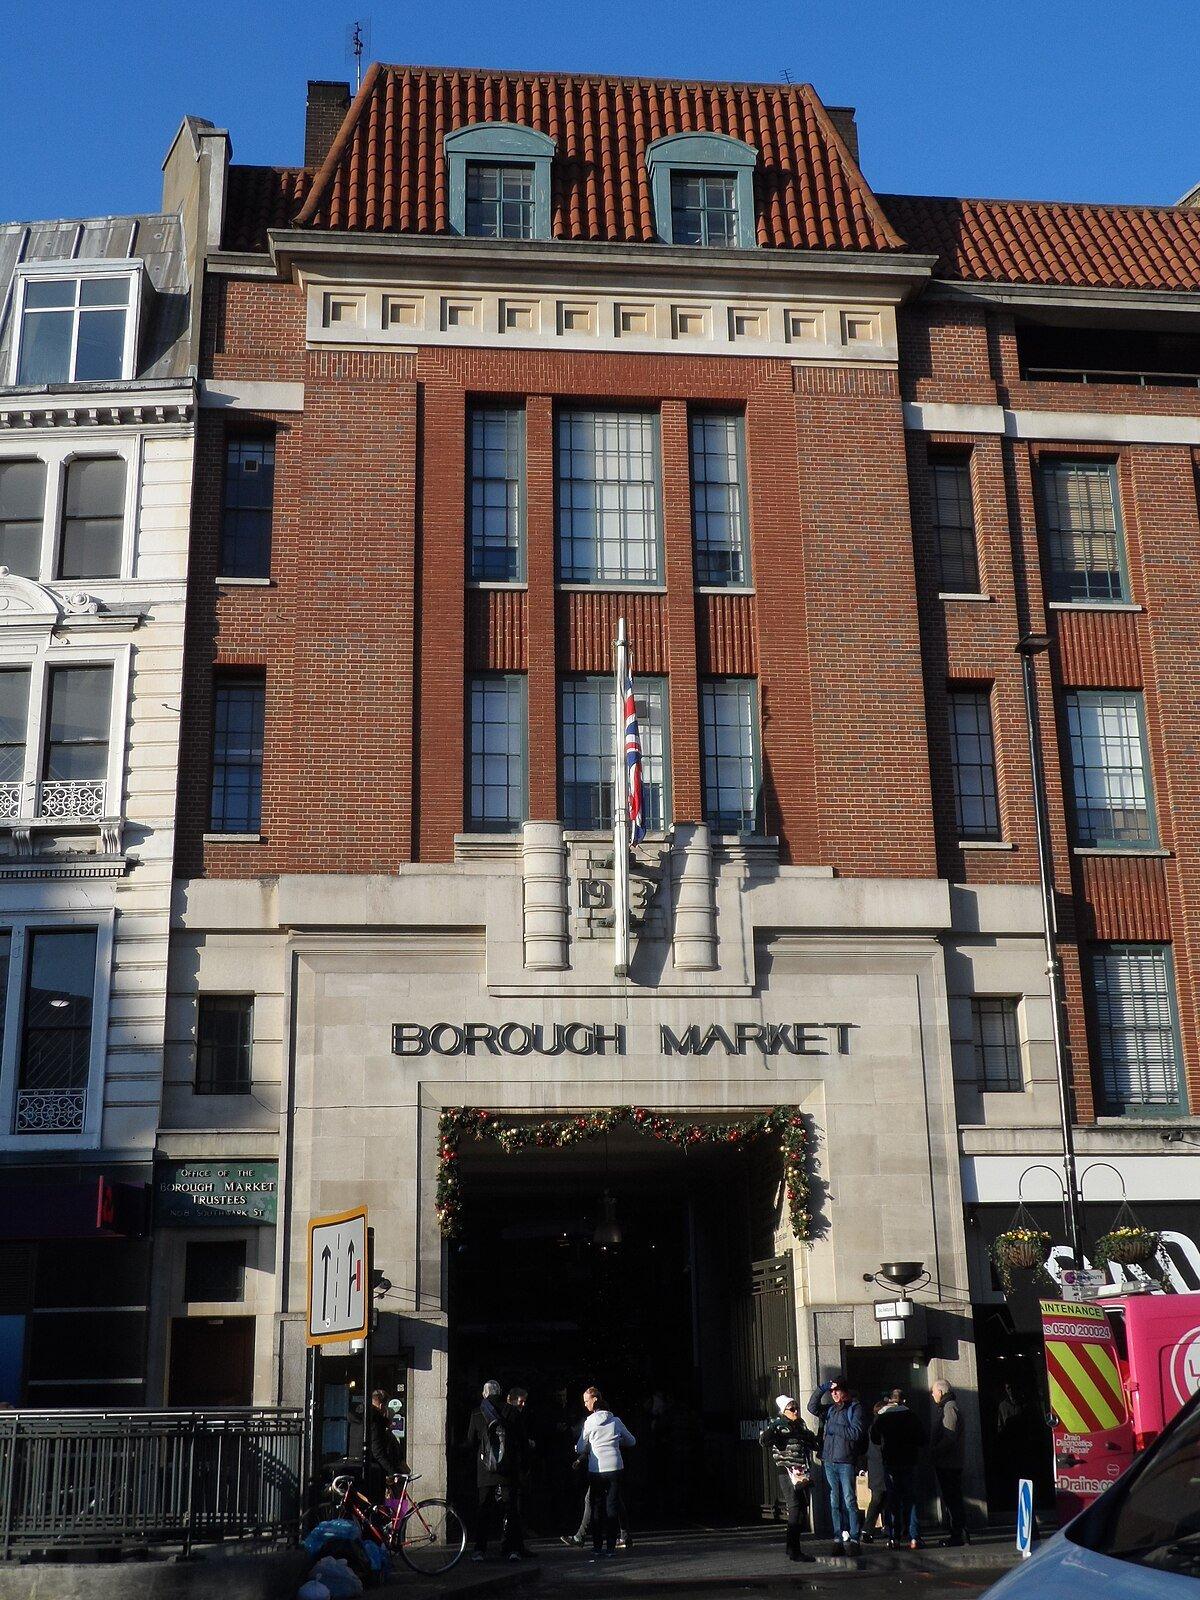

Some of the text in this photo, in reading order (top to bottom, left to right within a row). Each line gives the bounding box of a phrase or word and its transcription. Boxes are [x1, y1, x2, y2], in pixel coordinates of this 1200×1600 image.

[391, 1022, 860, 1056] BOROUGH MARKET
[160, 1182, 276, 1193] BOROUGH MARKET
[193, 1195, 247, 1205] TRUSTEES
[1053, 1324, 1076, 1335] 0500
[1077, 1325, 1111, 1338] 200024
